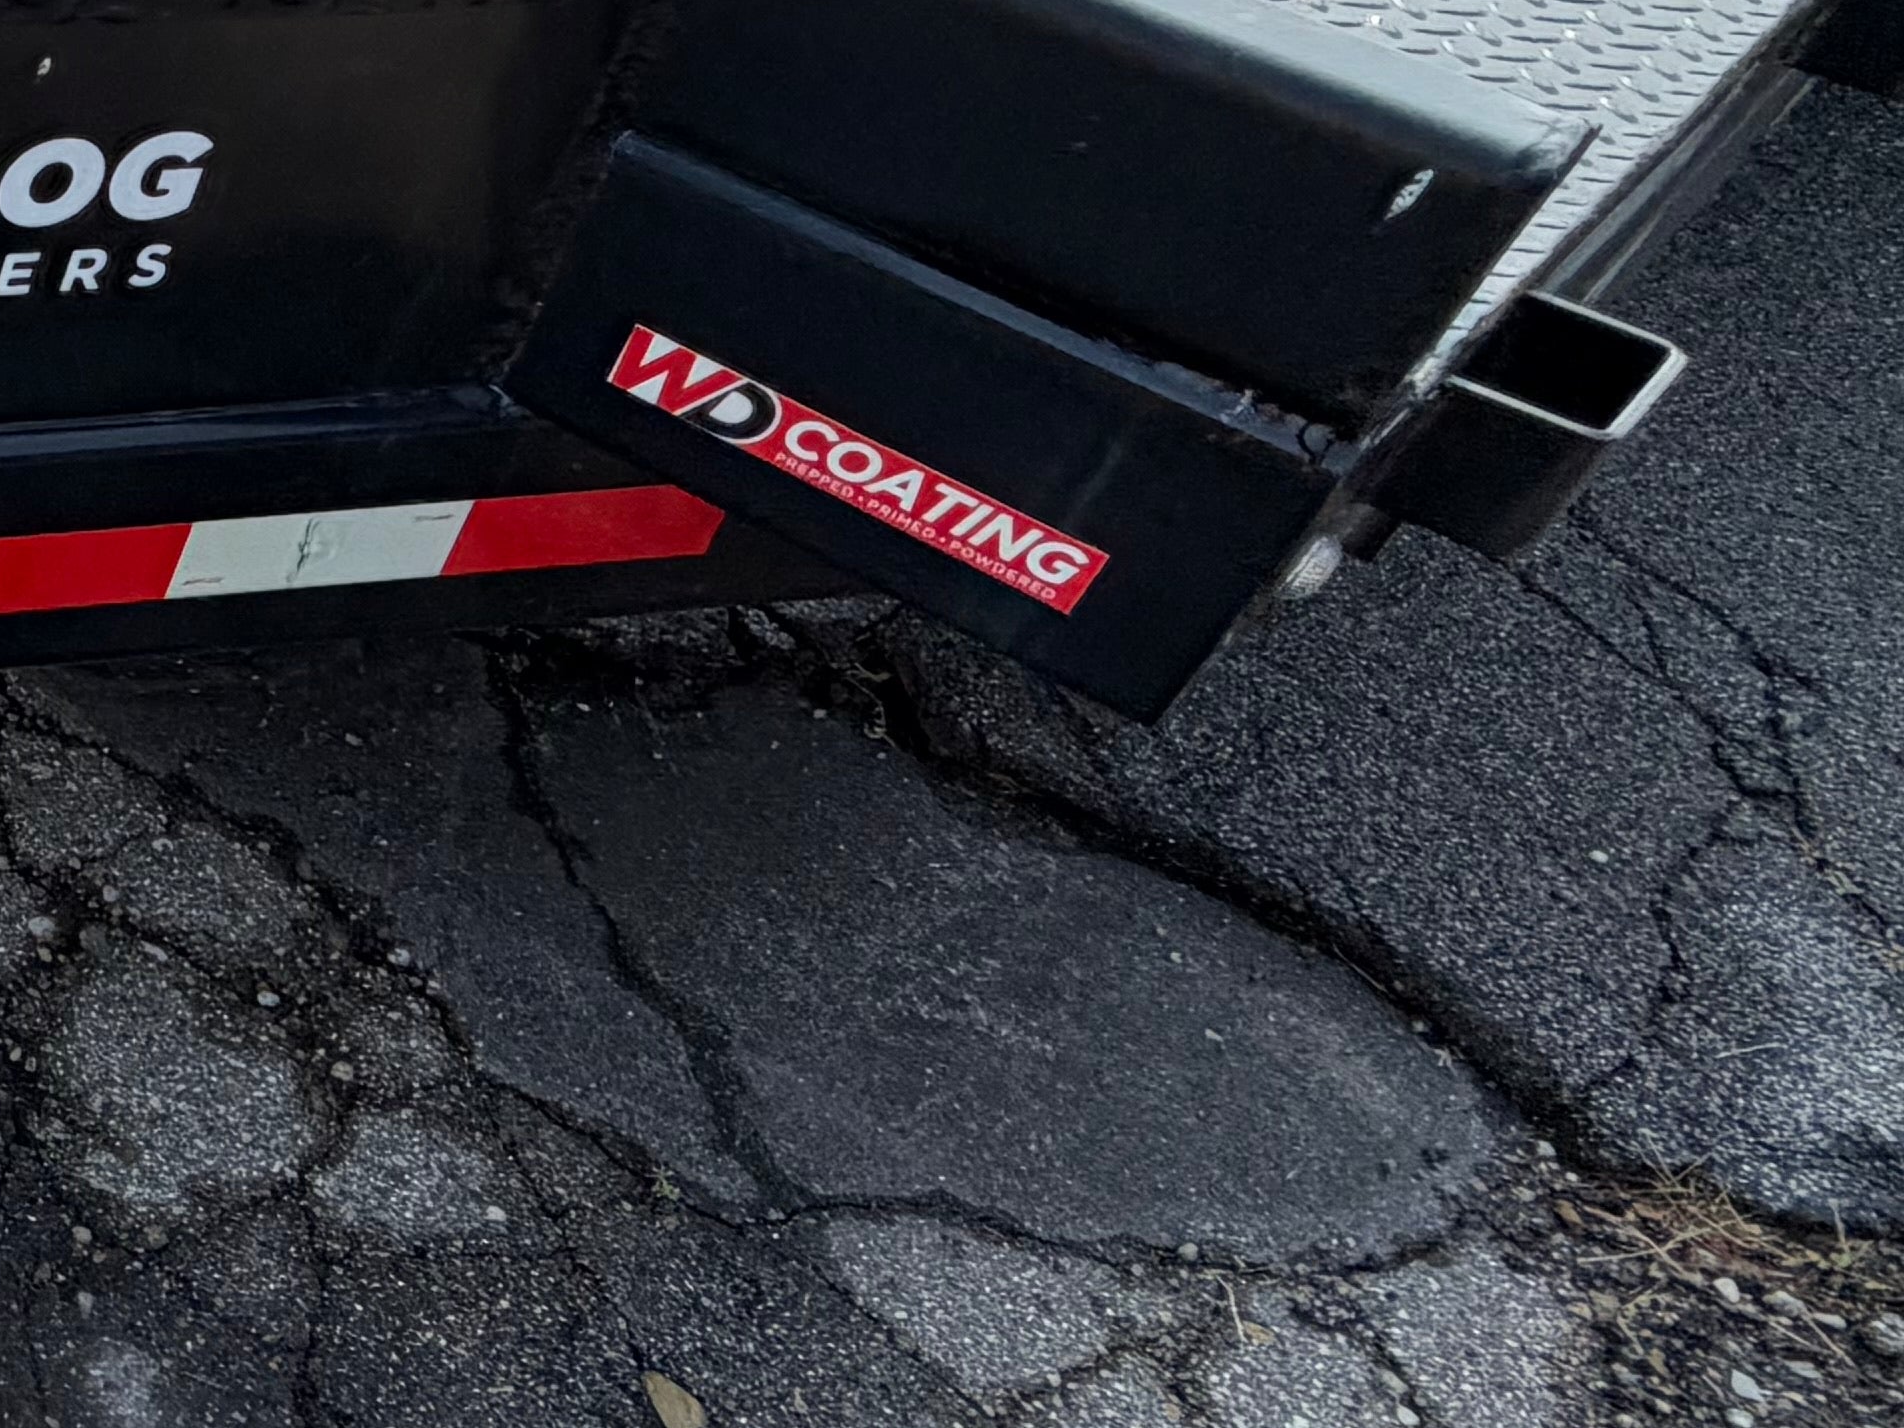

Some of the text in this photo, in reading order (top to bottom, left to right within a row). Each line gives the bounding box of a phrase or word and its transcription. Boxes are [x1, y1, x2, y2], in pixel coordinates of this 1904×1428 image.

[609, 325, 1090, 585] WD COATING
[773, 451, 855, 500] PREPPED
[948, 538, 1058, 601] POWDERED
